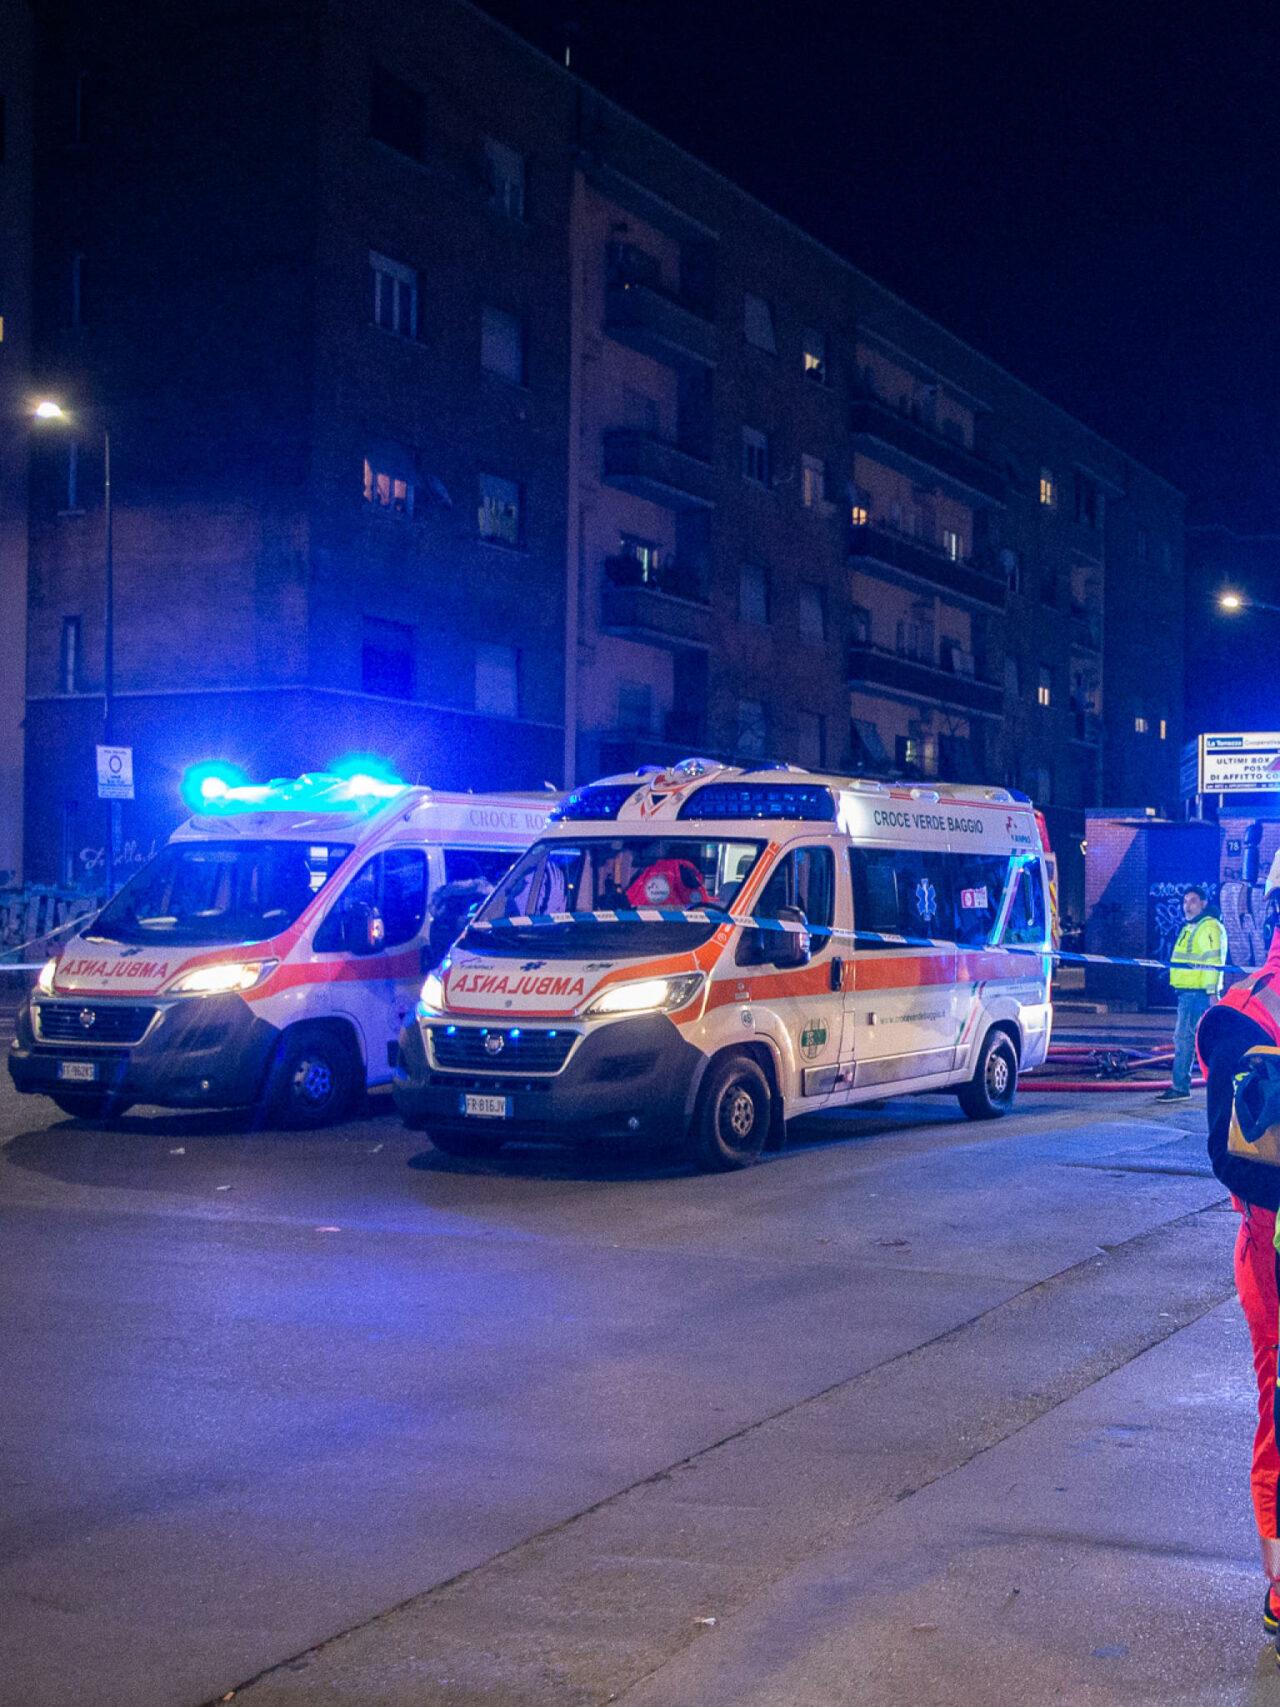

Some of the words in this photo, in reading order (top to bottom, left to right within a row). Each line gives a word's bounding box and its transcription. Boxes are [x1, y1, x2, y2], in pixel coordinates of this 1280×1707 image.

[1216, 757, 1247, 765] ULTIMI
[1223, 773, 1263, 781] AFFITTO
[469, 809, 518, 829] CROCE
[873, 810, 911, 829] CROCE
[913, 814, 946, 831] VERDE
[947, 817, 984, 834] BAGGIO
